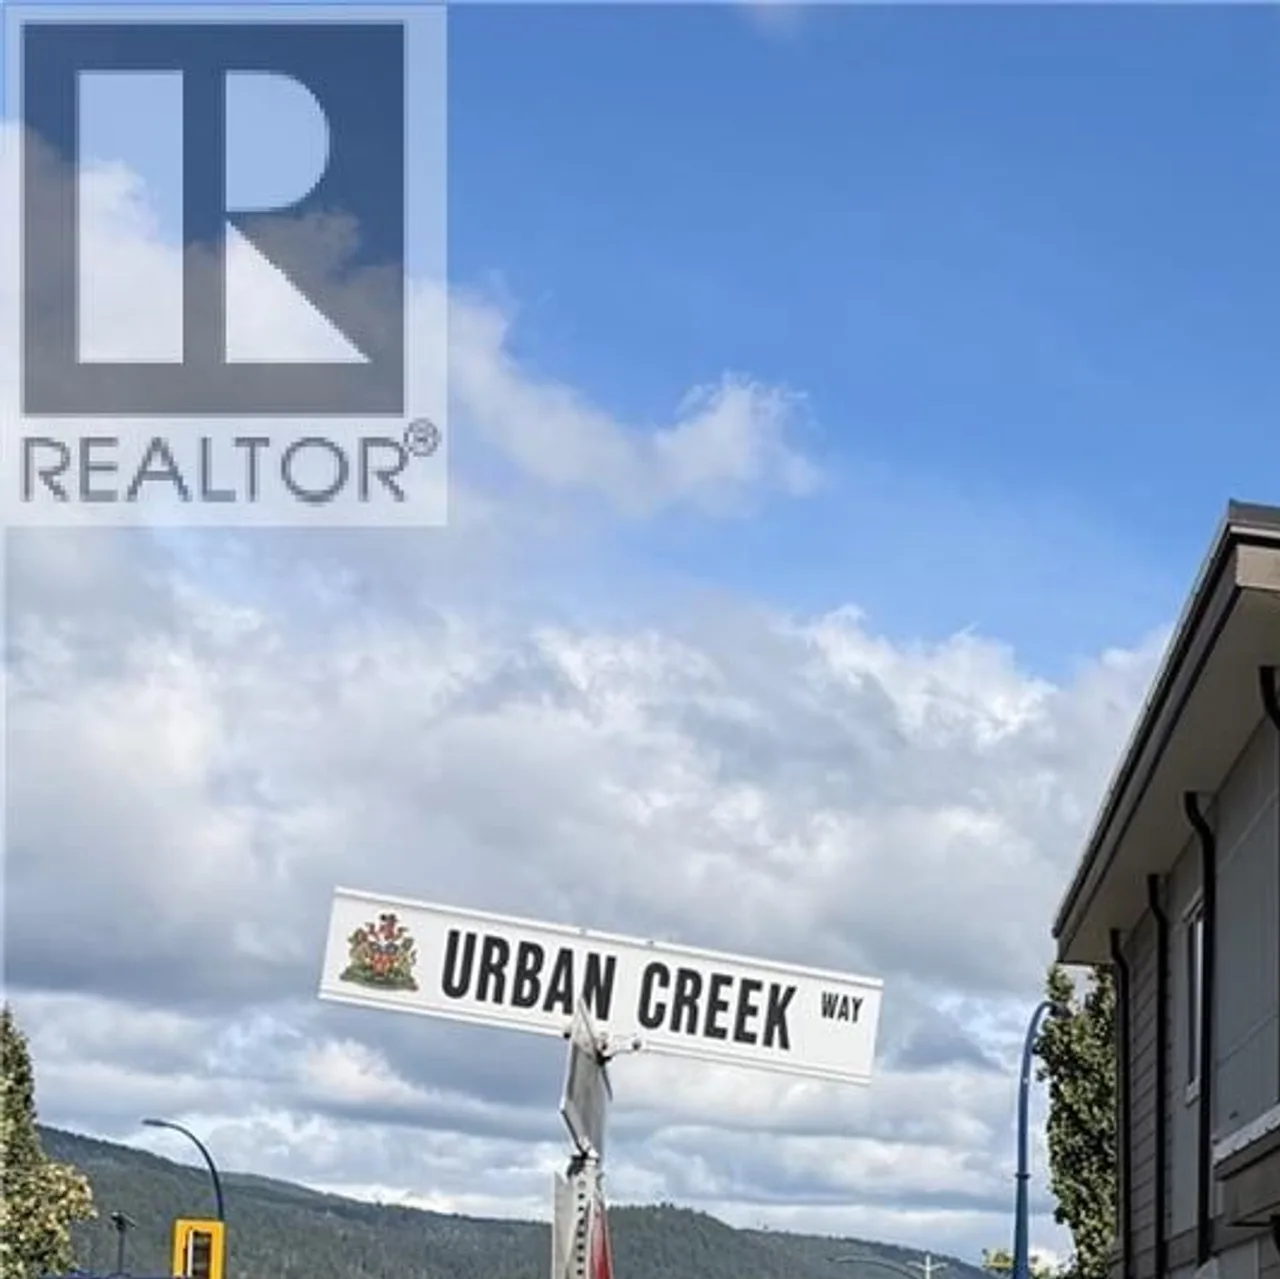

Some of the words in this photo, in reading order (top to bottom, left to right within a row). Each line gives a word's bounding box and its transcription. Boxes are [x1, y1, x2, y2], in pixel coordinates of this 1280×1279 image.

[440, 928, 617, 1022] URBAN
[636, 961, 798, 1051] CREEK
[820, 990, 864, 1024] WAY
